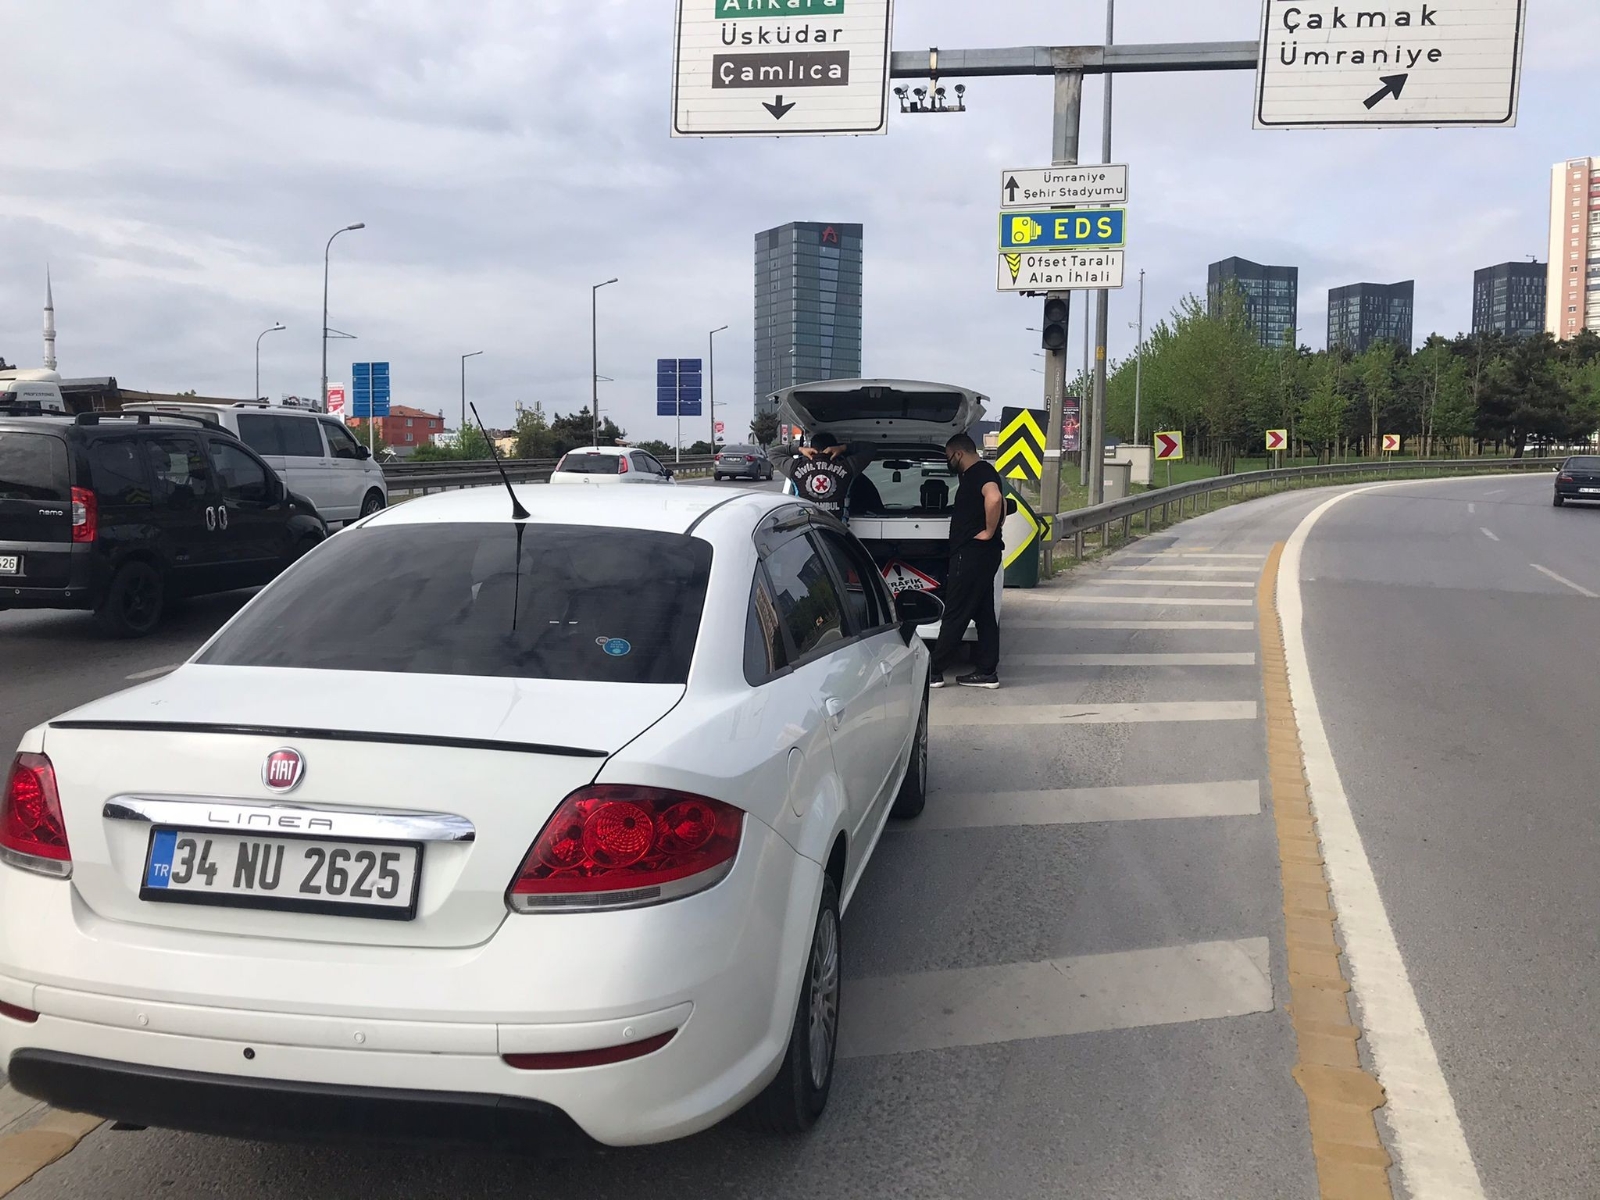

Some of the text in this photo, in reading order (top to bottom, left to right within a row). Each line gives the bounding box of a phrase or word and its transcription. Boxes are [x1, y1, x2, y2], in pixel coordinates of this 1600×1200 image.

[1283, 4, 1438, 33] Çakmak
[721, 23, 843, 45] Üsküdar
[1280, 41, 1442, 68] Ümraniye
[719, 60, 842, 84] Çamlıca
[1044, 172, 1106, 183] Ümraniye
[1024, 186, 1123, 199] Şehir Stadyumu
[1054, 217, 1112, 239] EDS
[1027, 255, 1115, 268] Ofset Taralı
[1029, 269, 1110, 283] Alan İhlali
[0, 558, 15, 568] 26
[893, 583, 924, 592] AZASI
[269, 759, 296, 780] FIAT
[207, 811, 333, 831] LINEA
[153, 863, 169, 876] TR
[171, 838, 401, 900] 34 NU 2625
